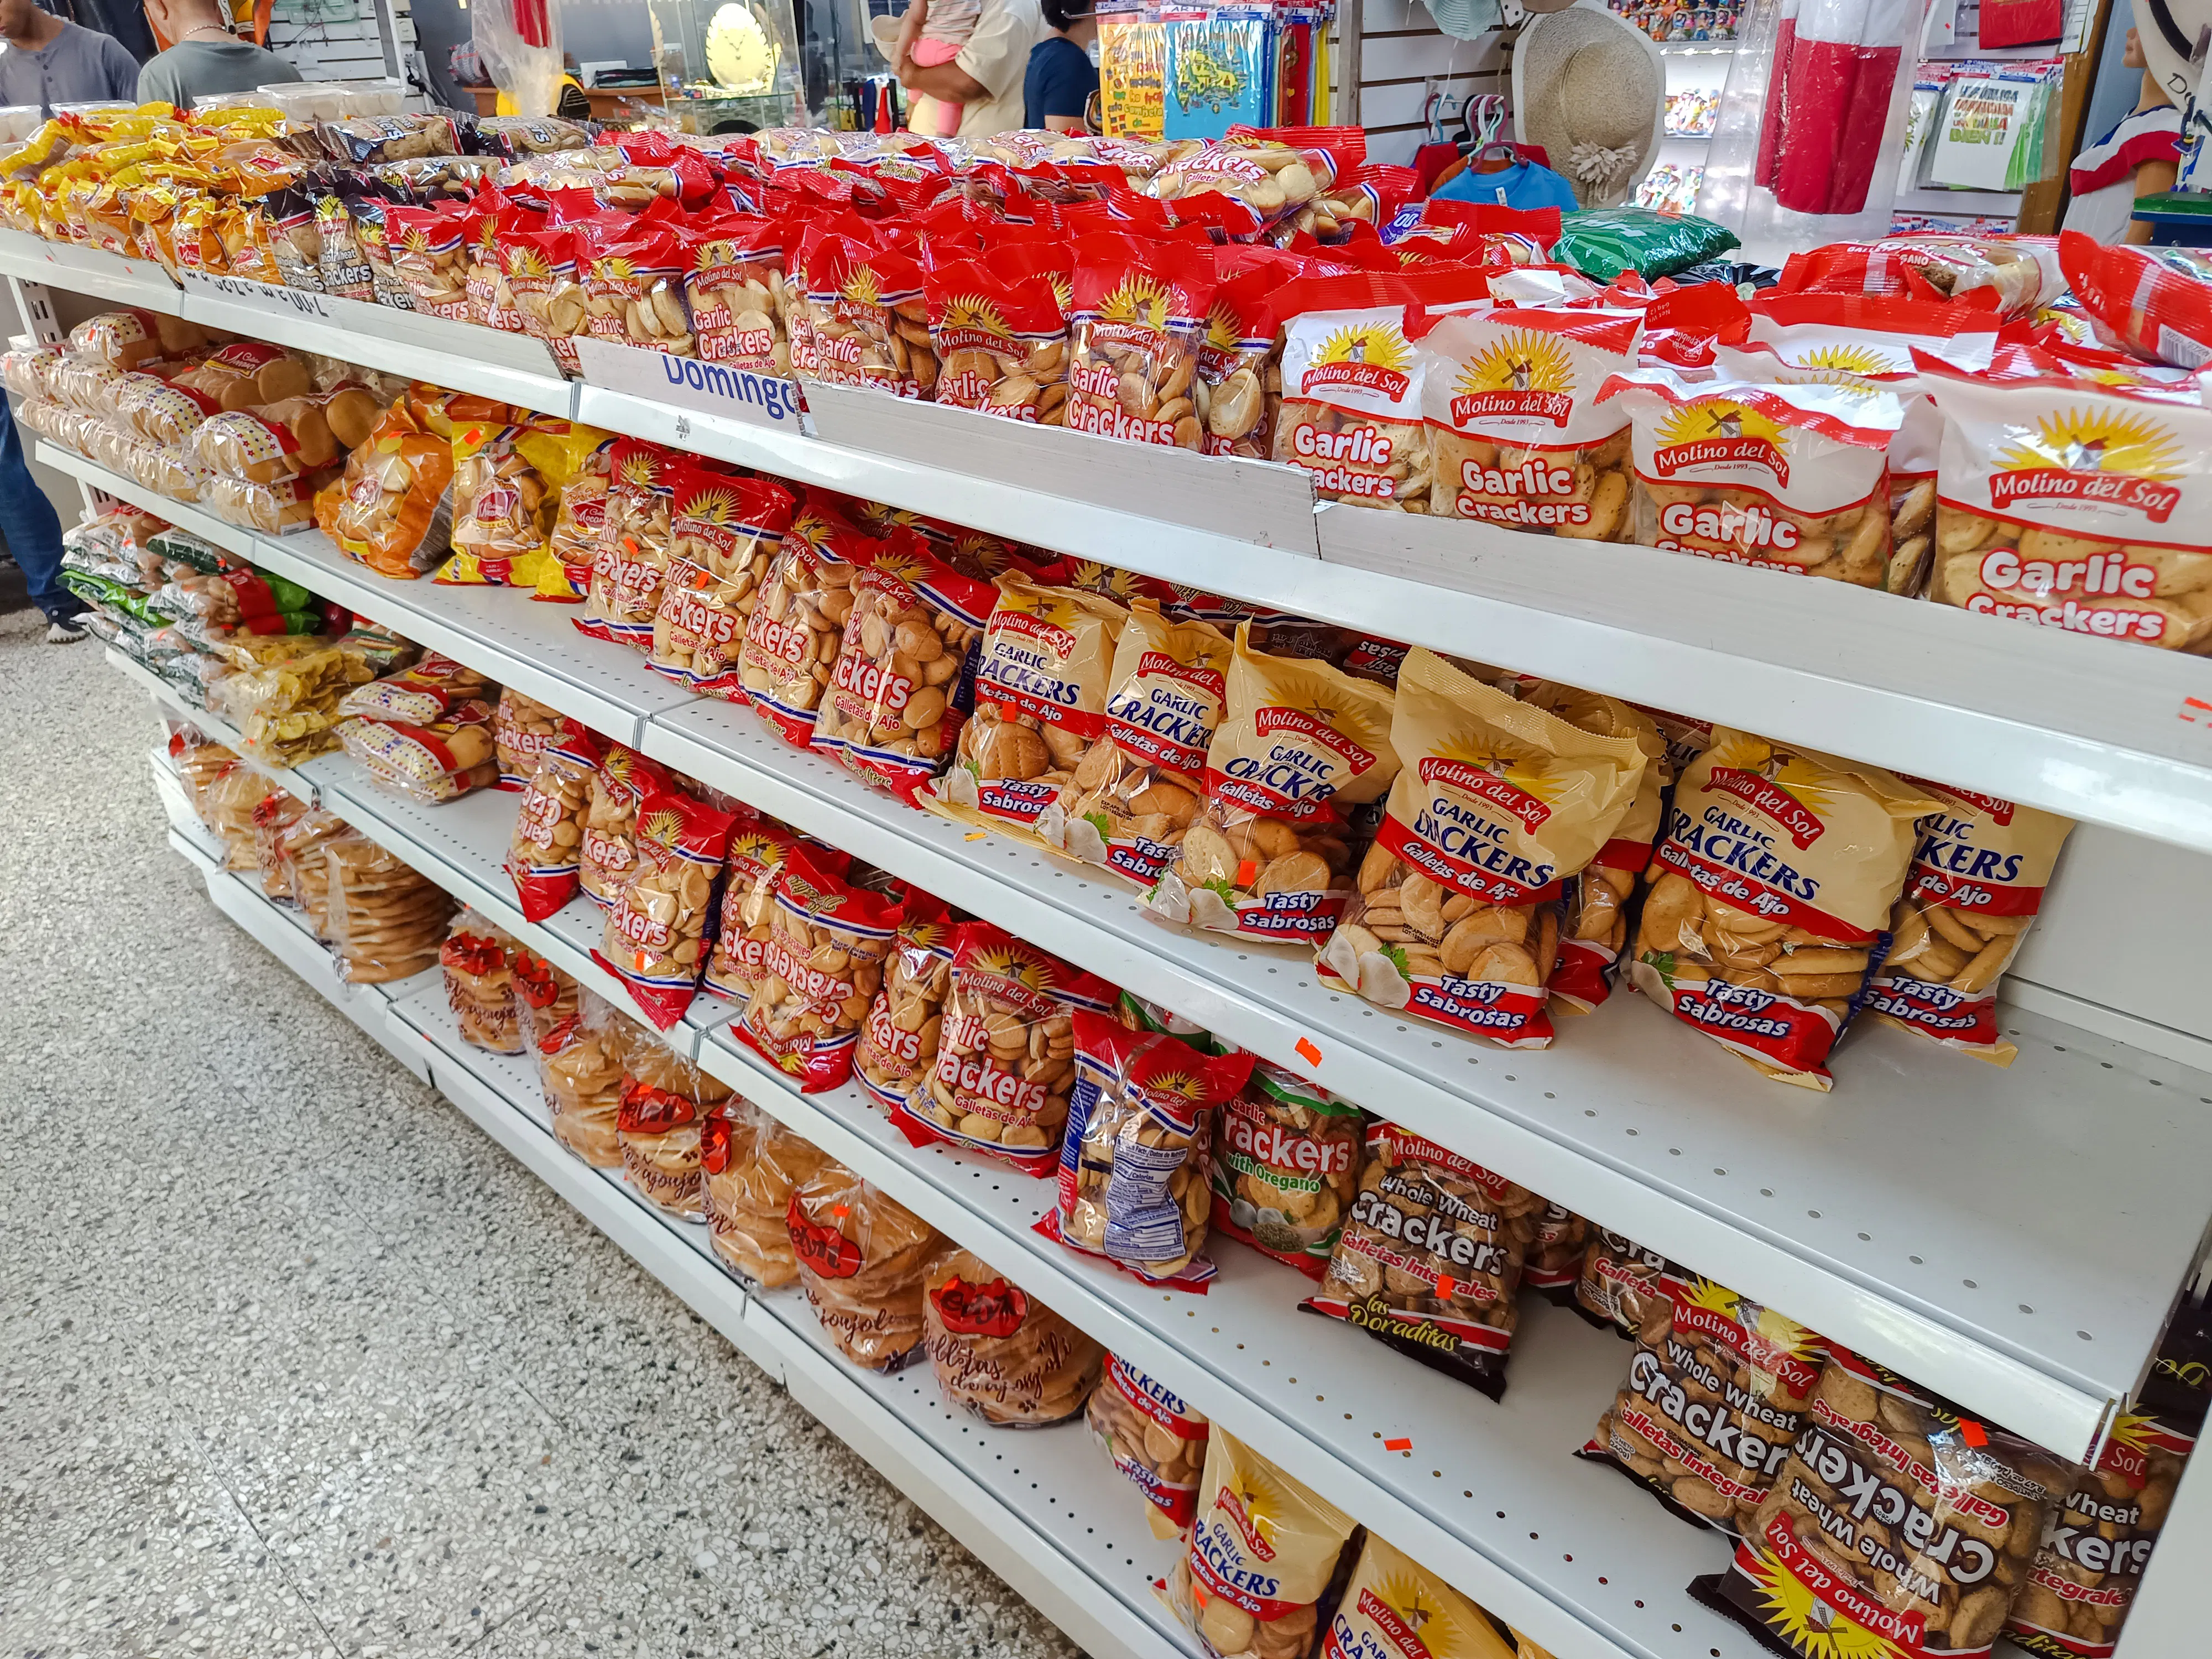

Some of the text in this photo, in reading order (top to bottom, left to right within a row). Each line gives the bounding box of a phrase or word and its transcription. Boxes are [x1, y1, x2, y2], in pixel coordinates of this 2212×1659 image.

[697, 270, 743, 289] Molino del Sol
[693, 304, 732, 331] Garlic
[1092, 324, 1134, 340] Molino
[1135, 332, 1154, 344] del
[700, 326, 773, 361] Crackers
[816, 332, 861, 364] Garlic
[940, 333, 1025, 359] Molino del Sol
[1200, 352, 1219, 367] del
[754, 359, 763, 368] de
[764, 358, 776, 369] Ajo
[1071, 360, 1119, 399] Garlic
[1305, 366, 1404, 394] Molino del Sol
[1337, 386, 1350, 394] Desde
[1456, 394, 1567, 418] Molino del Sol
[1070, 393, 1176, 446] Crackers
[1295, 424, 1391, 464] Garlic
[1660, 442, 1787, 478] Molino del Sol
[1463, 460, 1573, 495] Garlic
[1995, 473, 2171, 511] Molino del Sol
[1457, 498, 1590, 525] Crackers
[1663, 504, 1798, 549] Garlic
[703, 526, 732, 550] del Sol
[1981, 549, 2155, 598] Garlic
[992, 613, 1028, 634] Molino
[706, 646, 726, 661] Ajo
[995, 643, 1047, 670] GARLIC
[1141, 654, 1215, 685] Molino del
[835, 695, 900, 731] Galletas Ajo
[1020, 697, 1063, 721] de Ajo
[1151, 688, 1209, 719] GARLIC
[1259, 708, 1373, 768] Molino del Sol
[1160, 745, 1202, 770] de Ajo
[1270, 745, 1334, 780] GARLIC
[1002, 779, 1052, 798] Tasty
[1218, 781, 1316, 817] Galletas Ajo
[1421, 758, 1547, 826] Molino del Sol
[1460, 793, 1493, 812] Desde 1993
[1711, 769, 1822, 840] Molino del Sol
[1981, 795, 2012, 815] Sol
[1432, 798, 1510, 845] GARLIC
[1731, 797, 1760, 820] Desde 1993
[1703, 806, 1776, 850] GARLIC
[1414, 809, 1554, 887] CRACKERS
[1669, 806, 1820, 900] CRACKERS
[1402, 842, 1486, 891] Galletas de
[1265, 893, 1321, 911] Tasty
[1722, 879, 1790, 916] de Ajo
[1922, 873, 1992, 906] de Ajo
[1244, 914, 1334, 931] Sabrosas
[961, 974, 1051, 1018] Molino del Sol
[1441, 975, 1503, 1004] Tasty
[1707, 978, 1774, 1011] Tasty
[1892, 977, 1961, 1010] Tasty
[1415, 989, 1525, 1029] Sabrosas
[1678, 995, 1789, 1036] Sabrosas
[1863, 989, 1976, 1028] Sabrosas
[894, 1061, 912, 1078] Ajo
[955, 1095, 1016, 1126] Galletas de
[1231, 1097, 1265, 1126] Garlic
[1227, 1151, 1321, 1193] with Oregano
[1392, 1138, 1507, 1191] Molino del Sol
[1379, 1176, 1498, 1230] Whole Wheat
[1340, 1230, 1404, 1270] Galletas
[1352, 1193, 1507, 1274] Crackers
[1351, 1305, 1459, 1352] Doraditas
[1674, 1306, 1814, 1389] Molino del Sol
[1667, 1339, 1798, 1433] Whole Wheat
[1137, 1395, 1172, 1425] de Ajo
[2110, 1447, 2145, 1477] Sol
[1795, 1428, 1995, 1585] Crackers
[1213, 1523, 1246, 1566] GARLIC
[1790, 1477, 1941, 1606] Wheat Whole
[1217, 1583, 1261, 1614] de Ajo
[1770, 1522, 1919, 1644] Sol del Molino
[1360, 1591, 1423, 1658] Molino del
